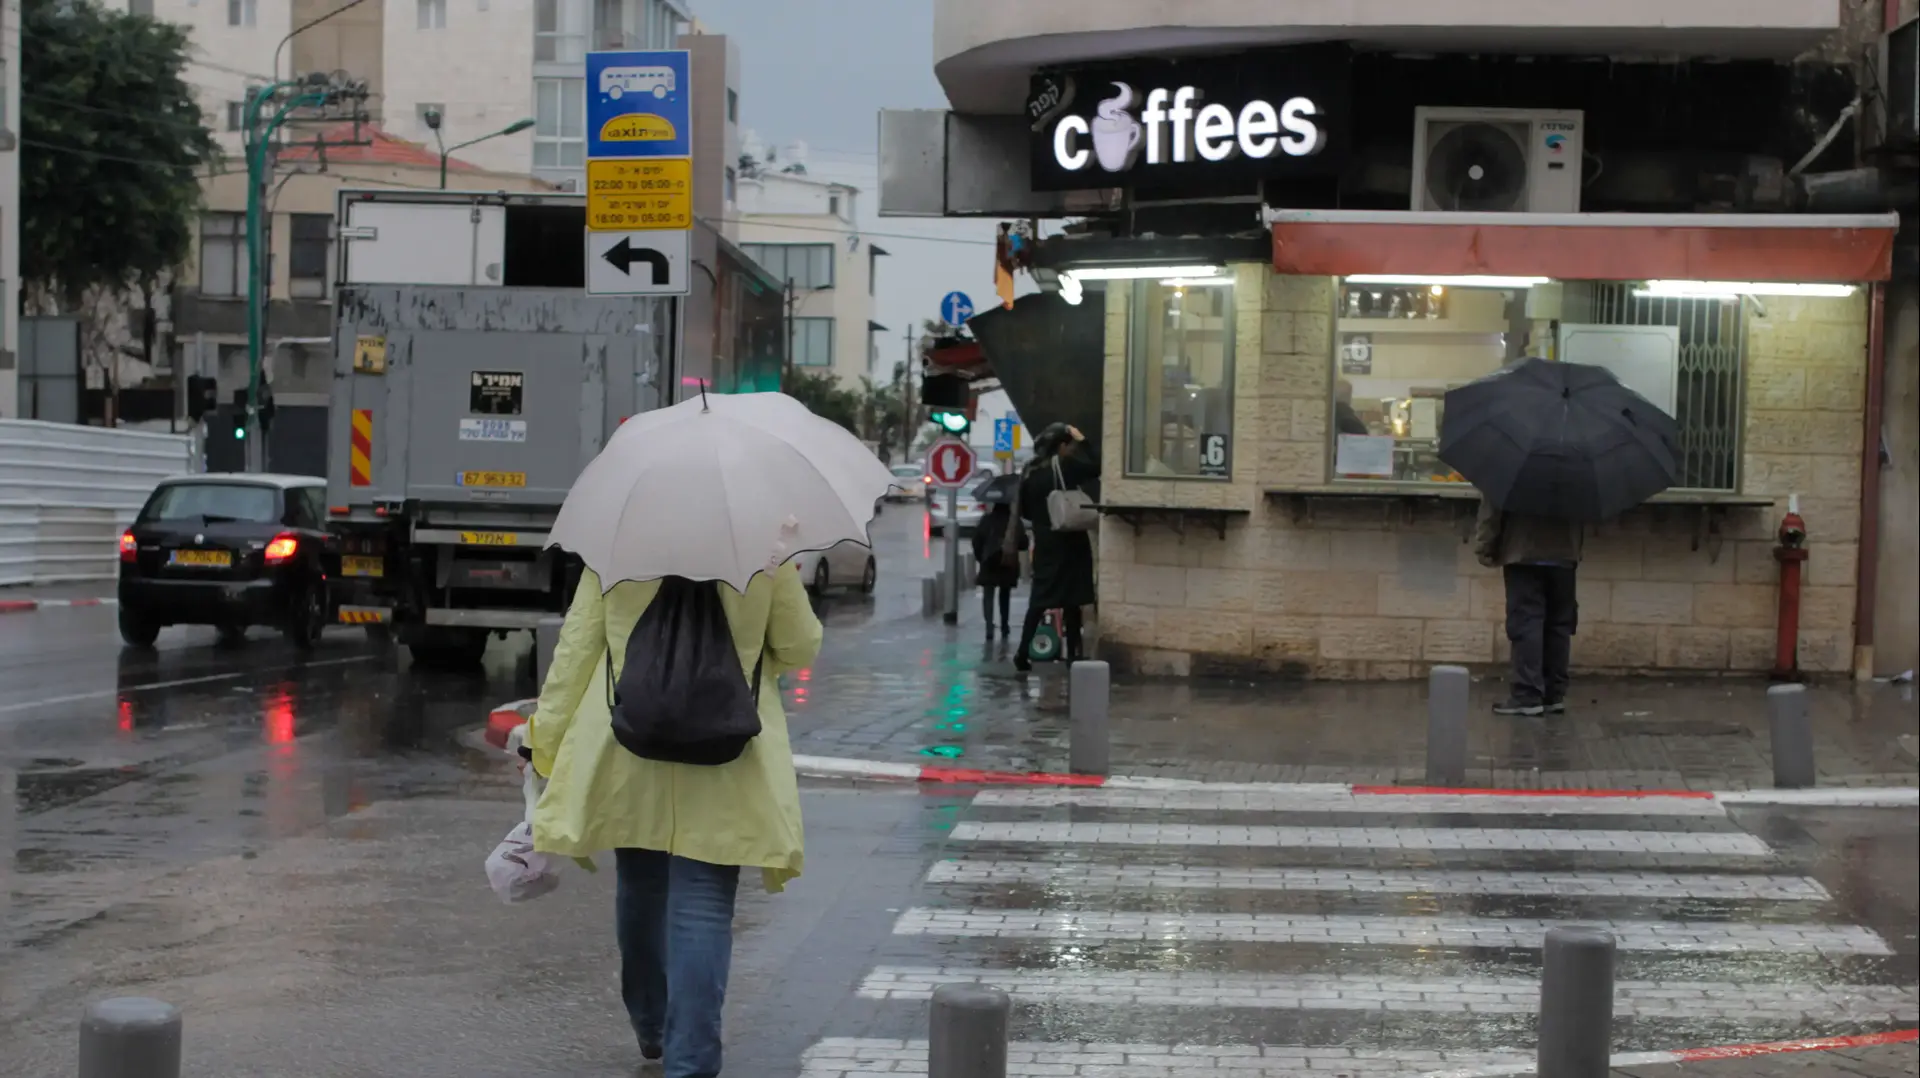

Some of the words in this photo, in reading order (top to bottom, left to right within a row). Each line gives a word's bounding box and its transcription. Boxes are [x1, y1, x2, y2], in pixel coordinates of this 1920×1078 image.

[1029, 79, 1059, 117] קפה
[483, 373, 522, 387] אמיר
[474, 532, 505, 545] אמיר
